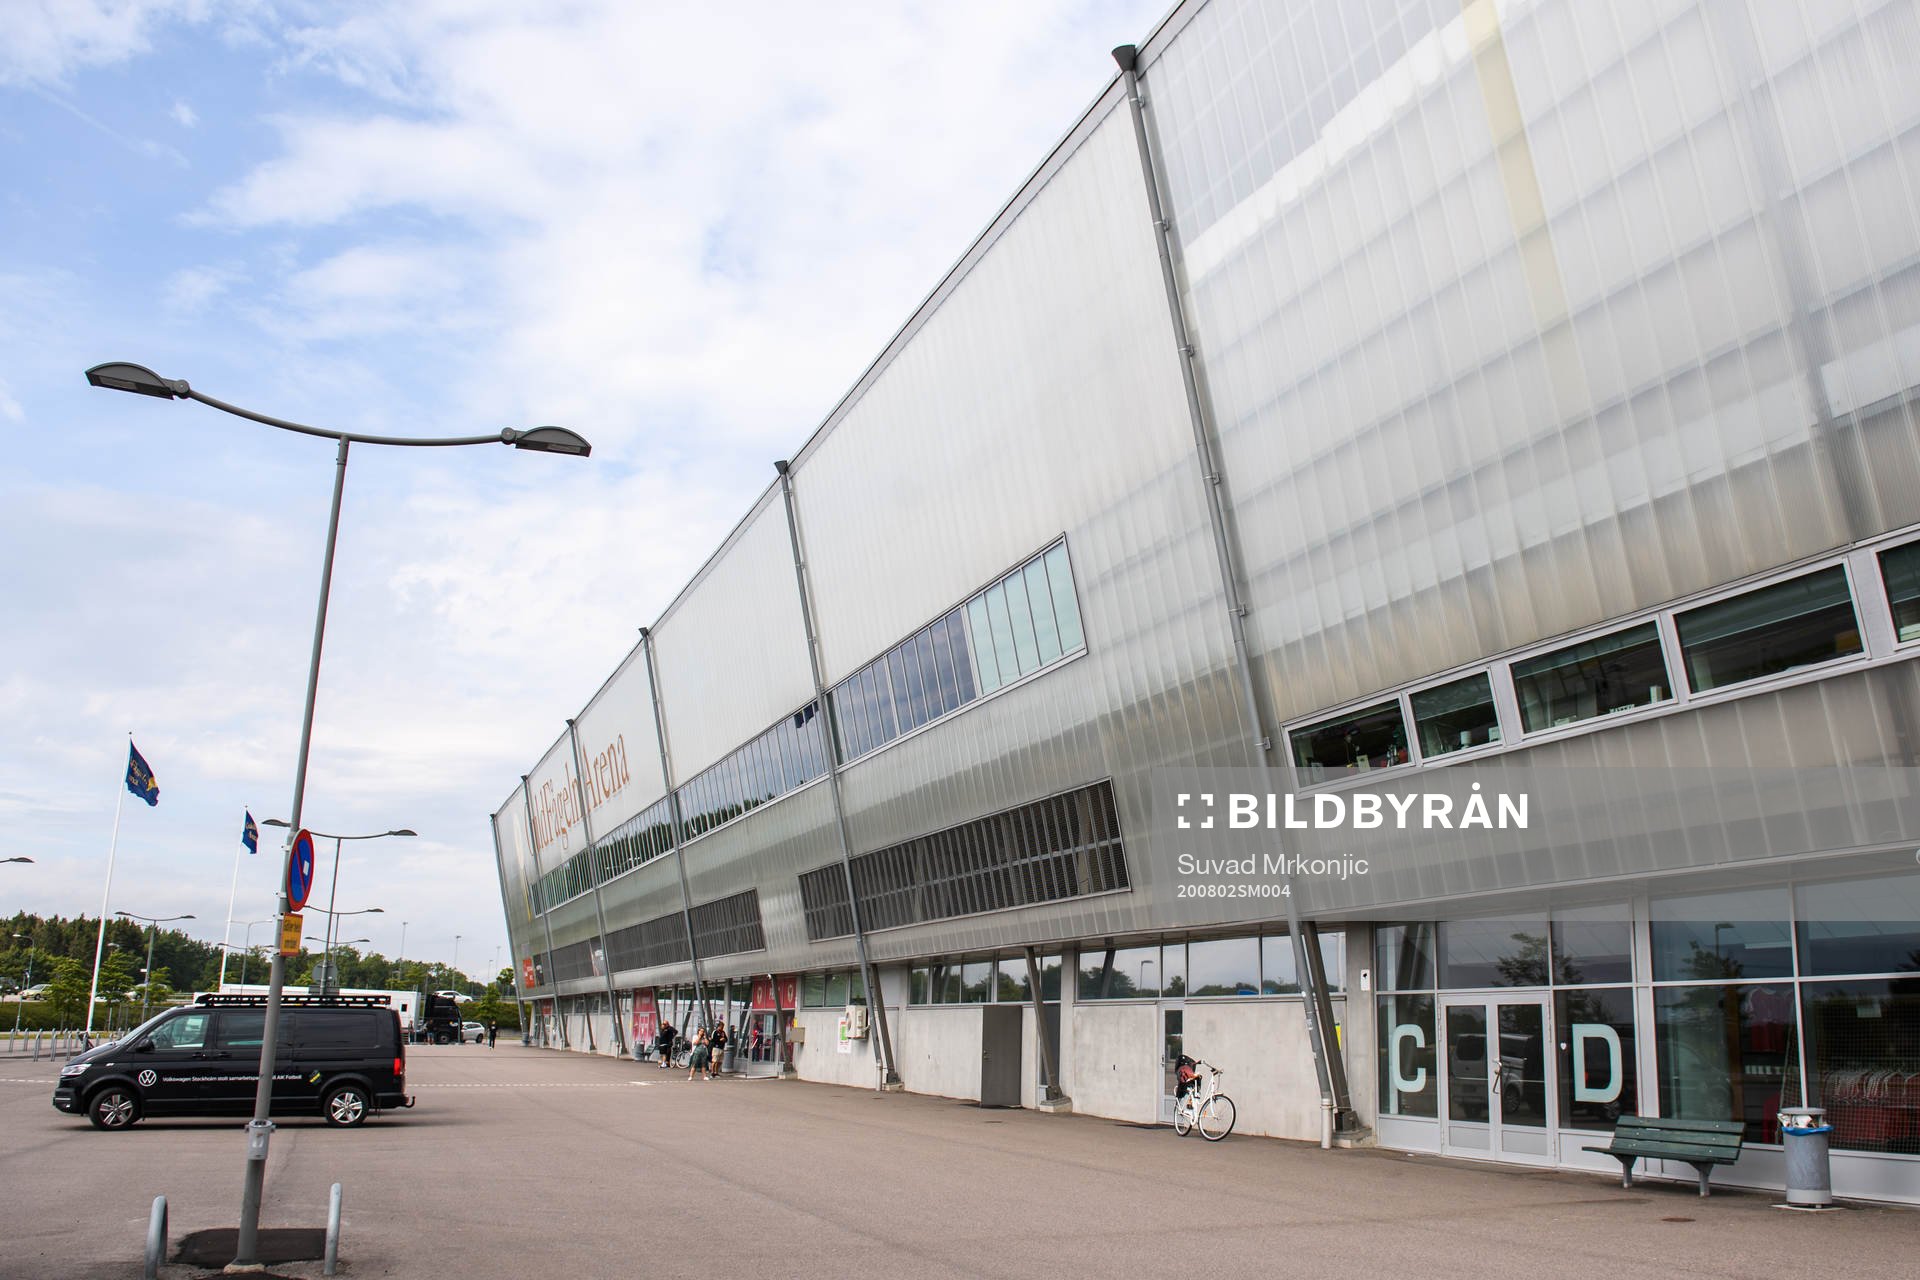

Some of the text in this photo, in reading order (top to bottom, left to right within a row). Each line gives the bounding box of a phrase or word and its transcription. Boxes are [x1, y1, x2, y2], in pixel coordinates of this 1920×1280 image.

[583, 733, 630, 815] Arena
[1392, 1023, 1427, 1093] C
[1571, 1023, 1623, 1104] D
